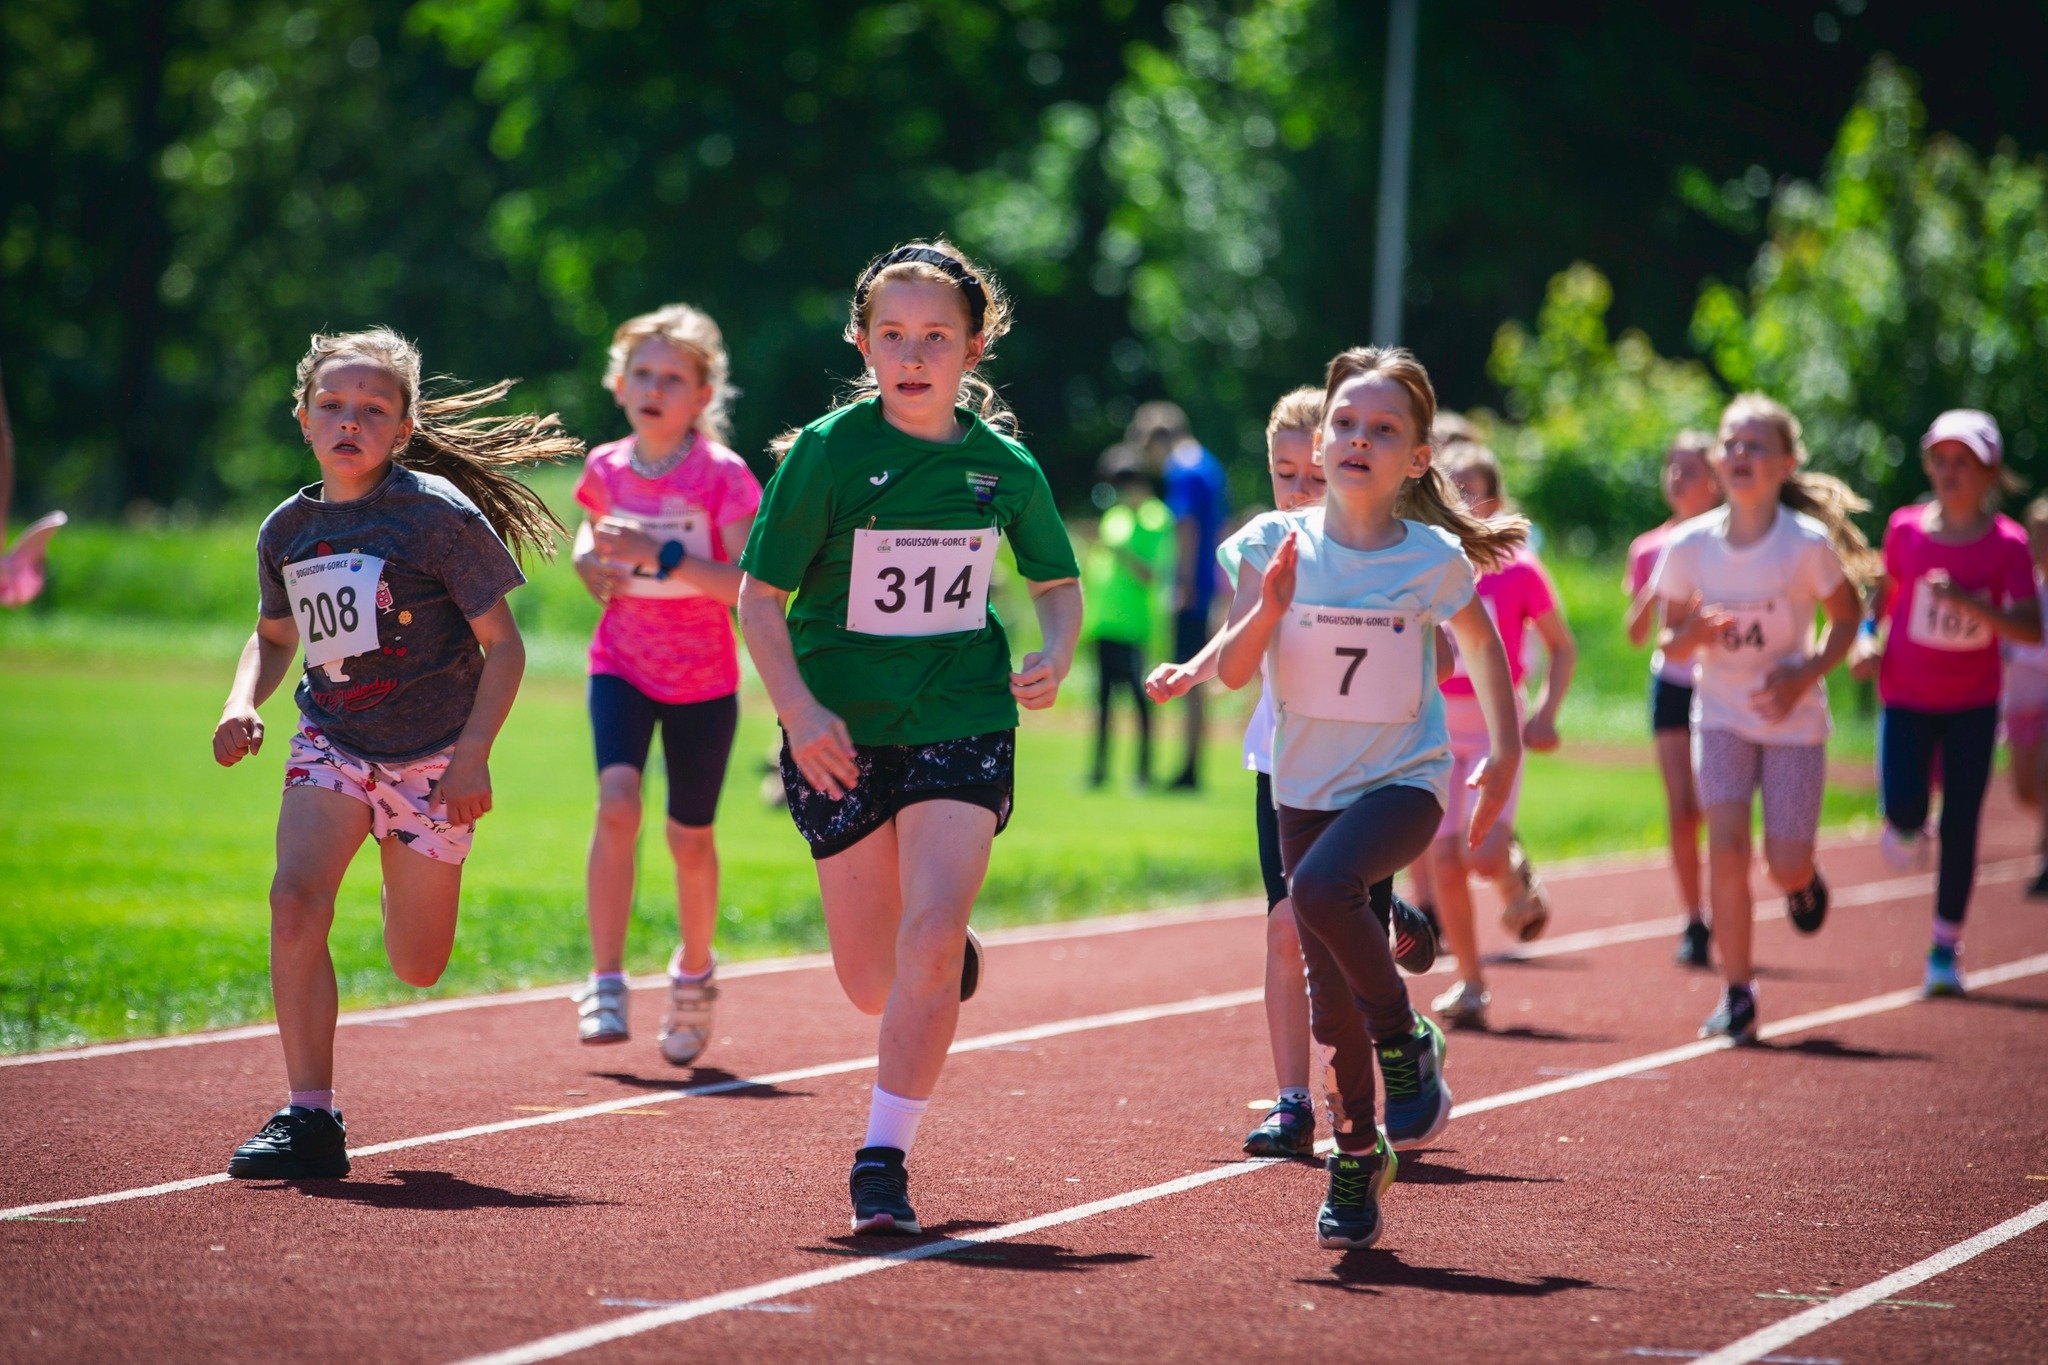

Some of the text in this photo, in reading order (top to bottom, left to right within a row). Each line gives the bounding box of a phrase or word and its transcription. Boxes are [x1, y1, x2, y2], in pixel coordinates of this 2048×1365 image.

[895, 537, 967, 547] BOGUSZÓW-GORCE
[296, 559, 348, 579] BOGUSZÓW-GORCE
[874, 564, 973, 614] 314
[300, 586, 359, 643] 208
[1317, 614, 1391, 627] BOGUSZÓW-GORCE
[1335, 646, 1368, 696] 7
[1382, 1048, 1403, 1059] FILA
[1340, 1161, 1359, 1169] FILA
